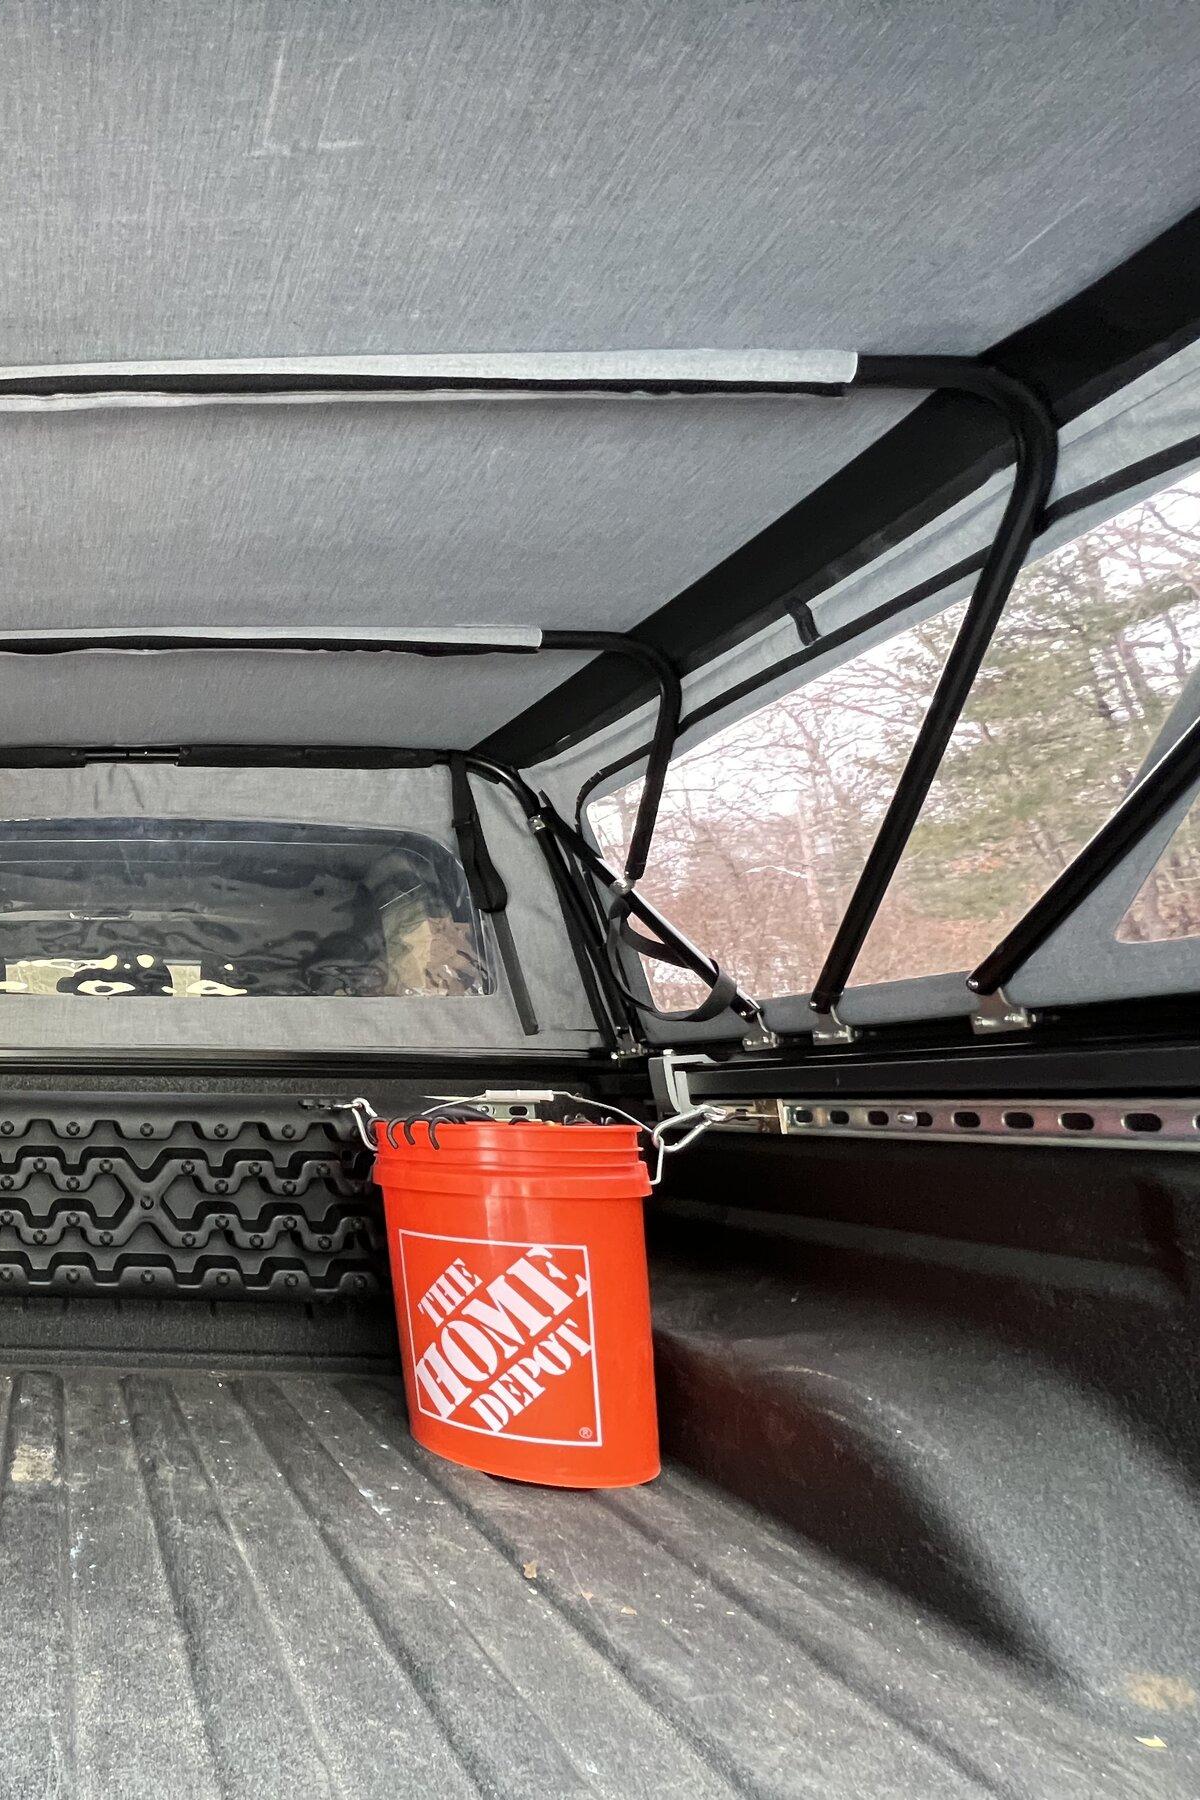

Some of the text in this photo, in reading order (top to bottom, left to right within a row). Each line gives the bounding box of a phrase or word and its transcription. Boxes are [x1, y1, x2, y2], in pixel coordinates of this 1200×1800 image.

[416, 1247, 589, 1419] HOME
[418, 1257, 483, 1328] THE
[470, 1318, 592, 1432] DEPOT
